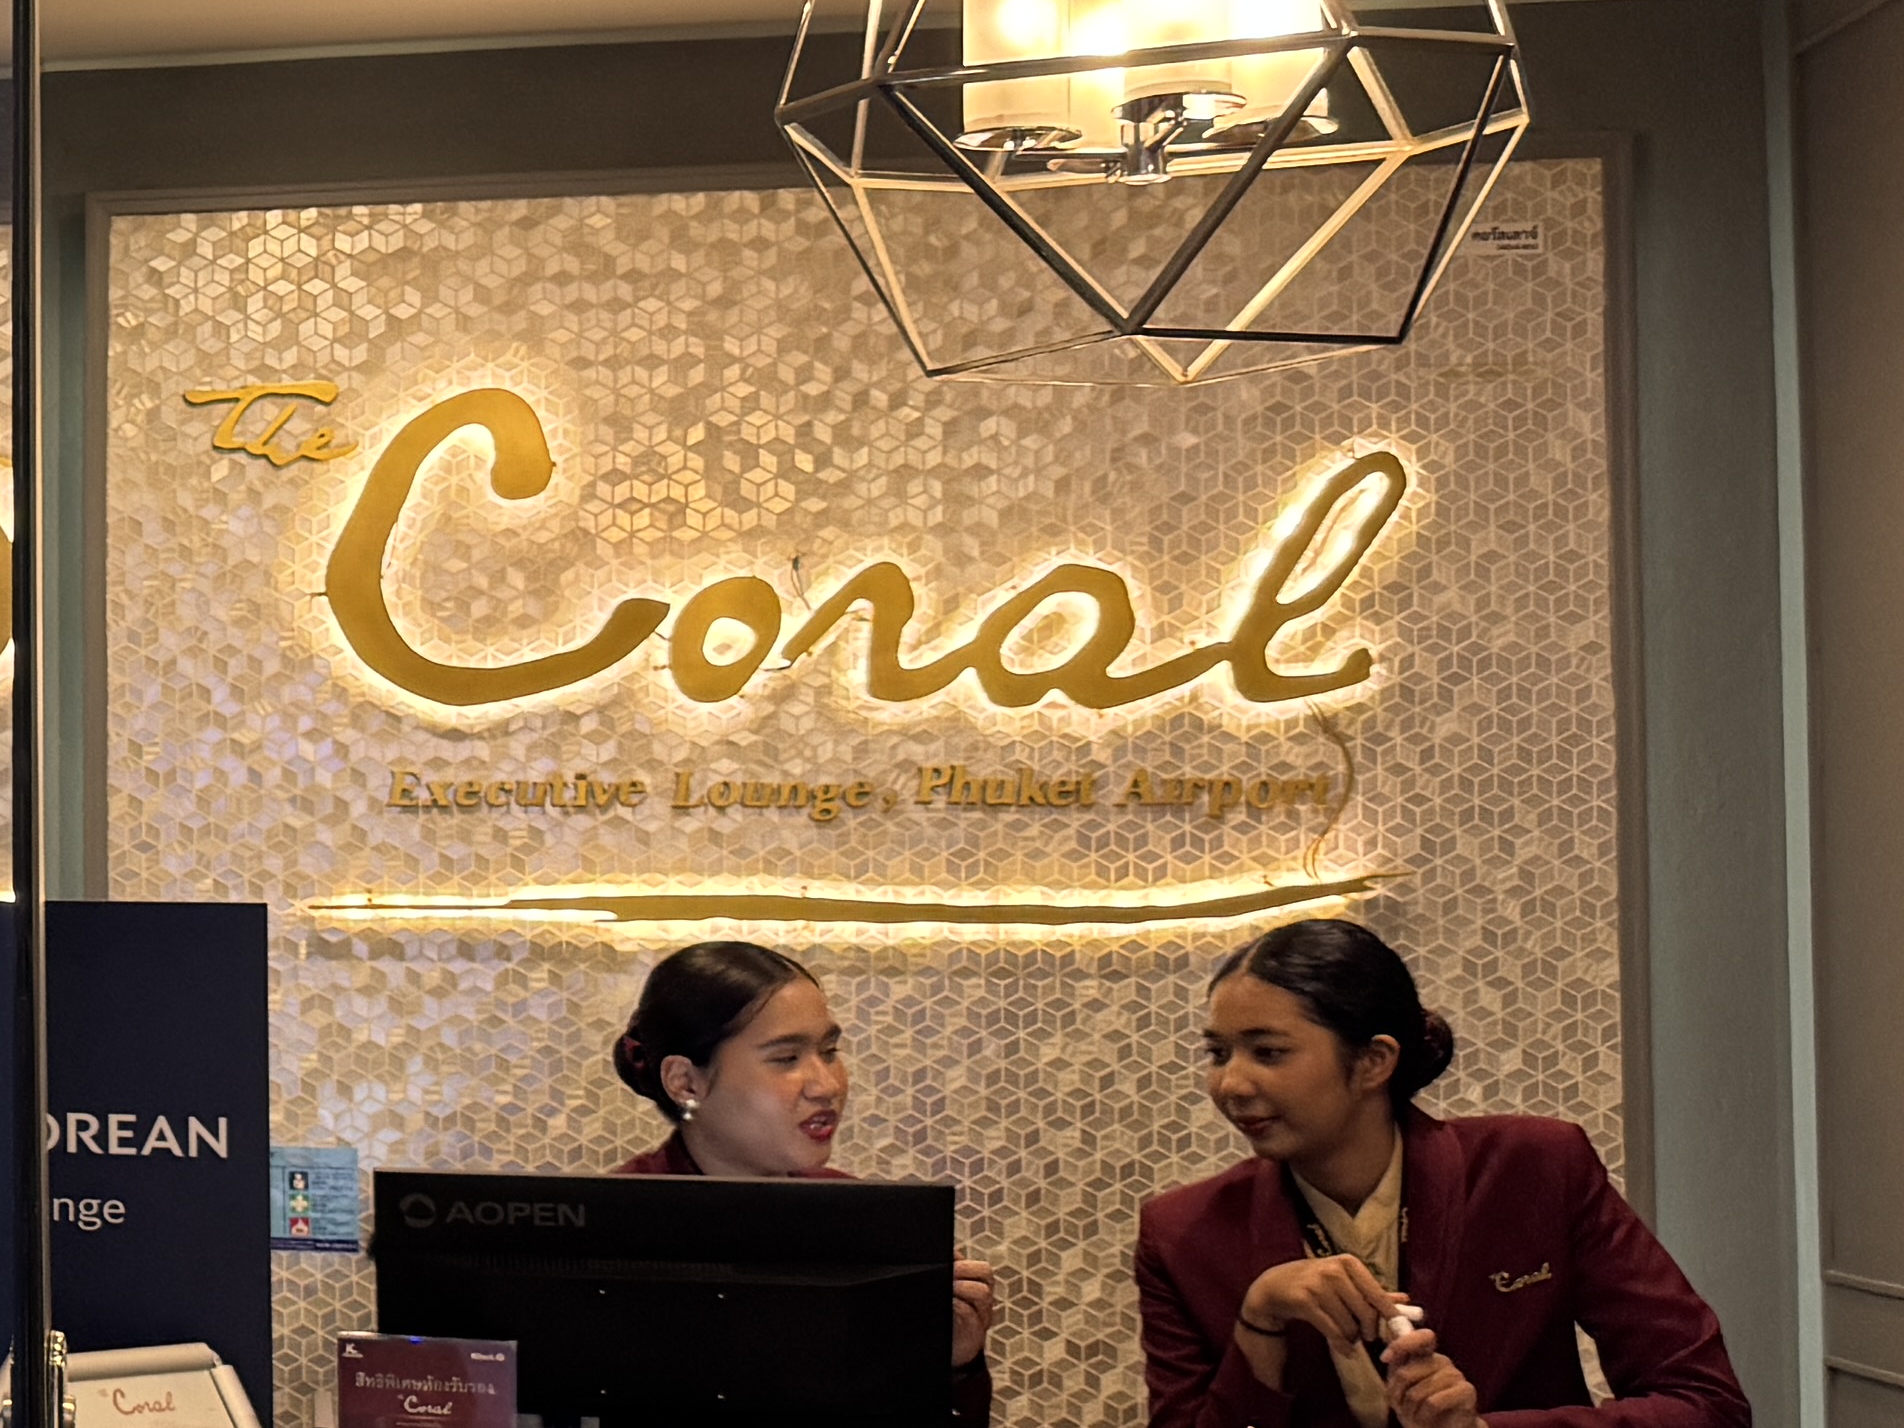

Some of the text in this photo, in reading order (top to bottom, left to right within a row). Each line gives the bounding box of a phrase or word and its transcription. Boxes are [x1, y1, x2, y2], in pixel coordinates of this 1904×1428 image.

[182, 380, 360, 466] The
[322, 387, 1408, 708] Coral
[387, 763, 1332, 822] Executive Lounge, Phuket Airport
[446, 1201, 586, 1227] AOPEN
[113, 1388, 176, 1416] Coral
[403, 1395, 454, 1416] Coral
